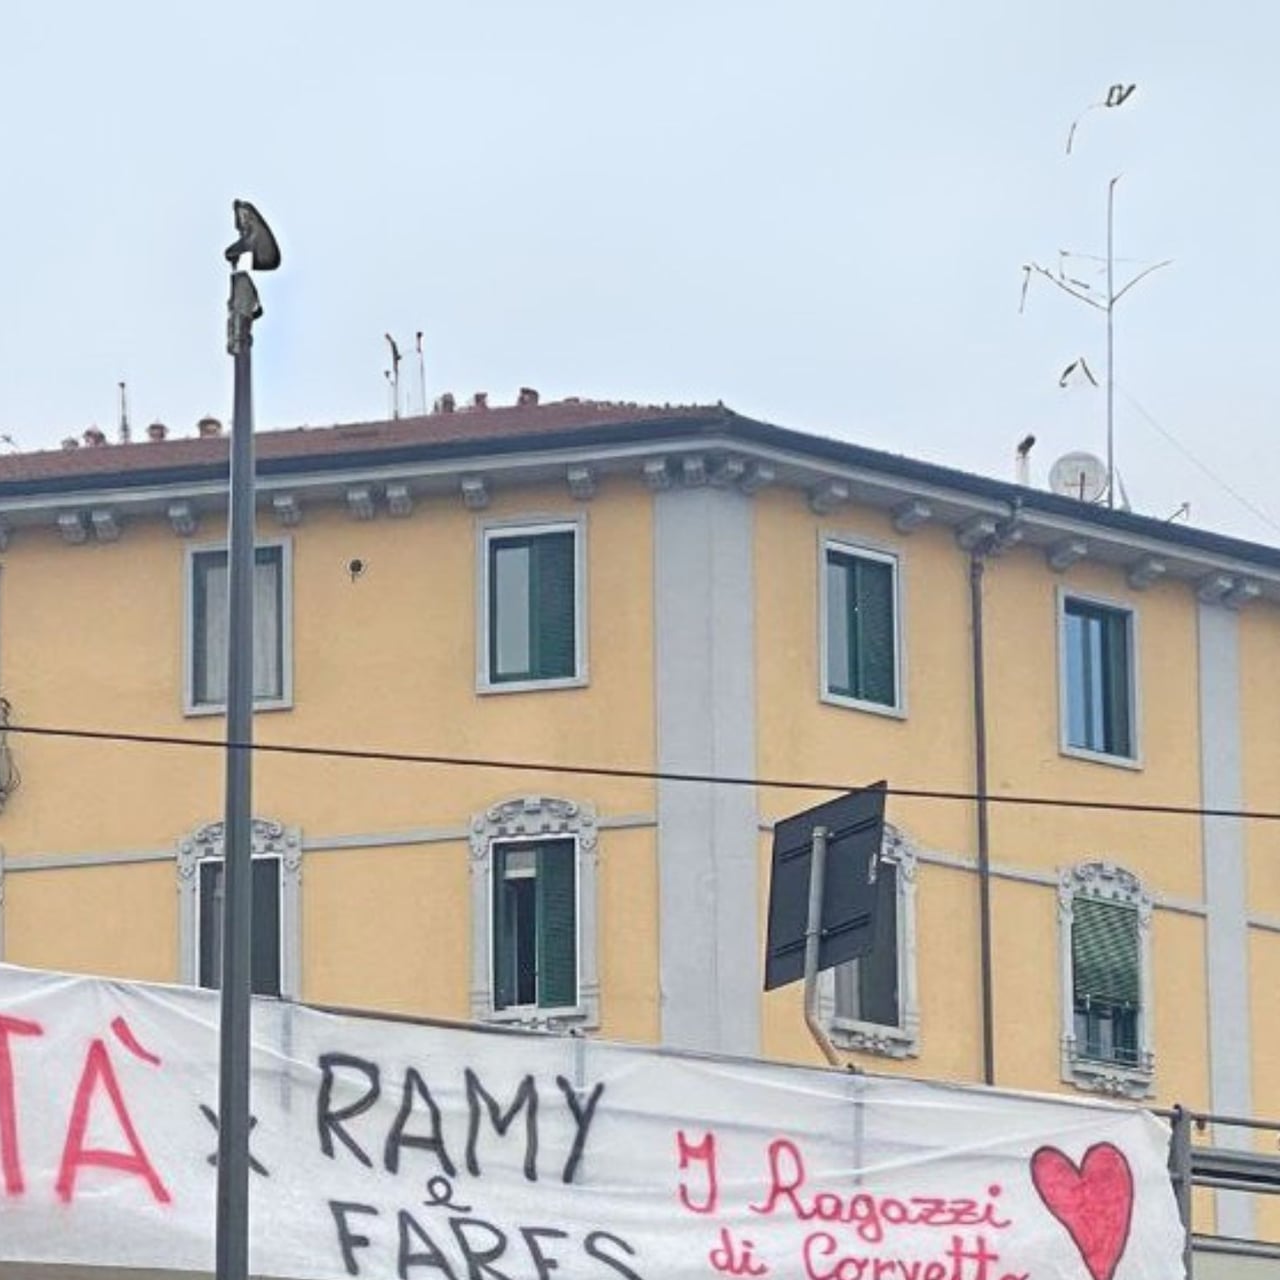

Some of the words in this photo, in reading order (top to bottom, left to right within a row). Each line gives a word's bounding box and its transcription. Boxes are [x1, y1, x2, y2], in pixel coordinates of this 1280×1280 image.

[319, 1053, 604, 1183] RAMY
[751, 1138, 1012, 1242] Ragazzi
[710, 1230, 767, 1277] di
